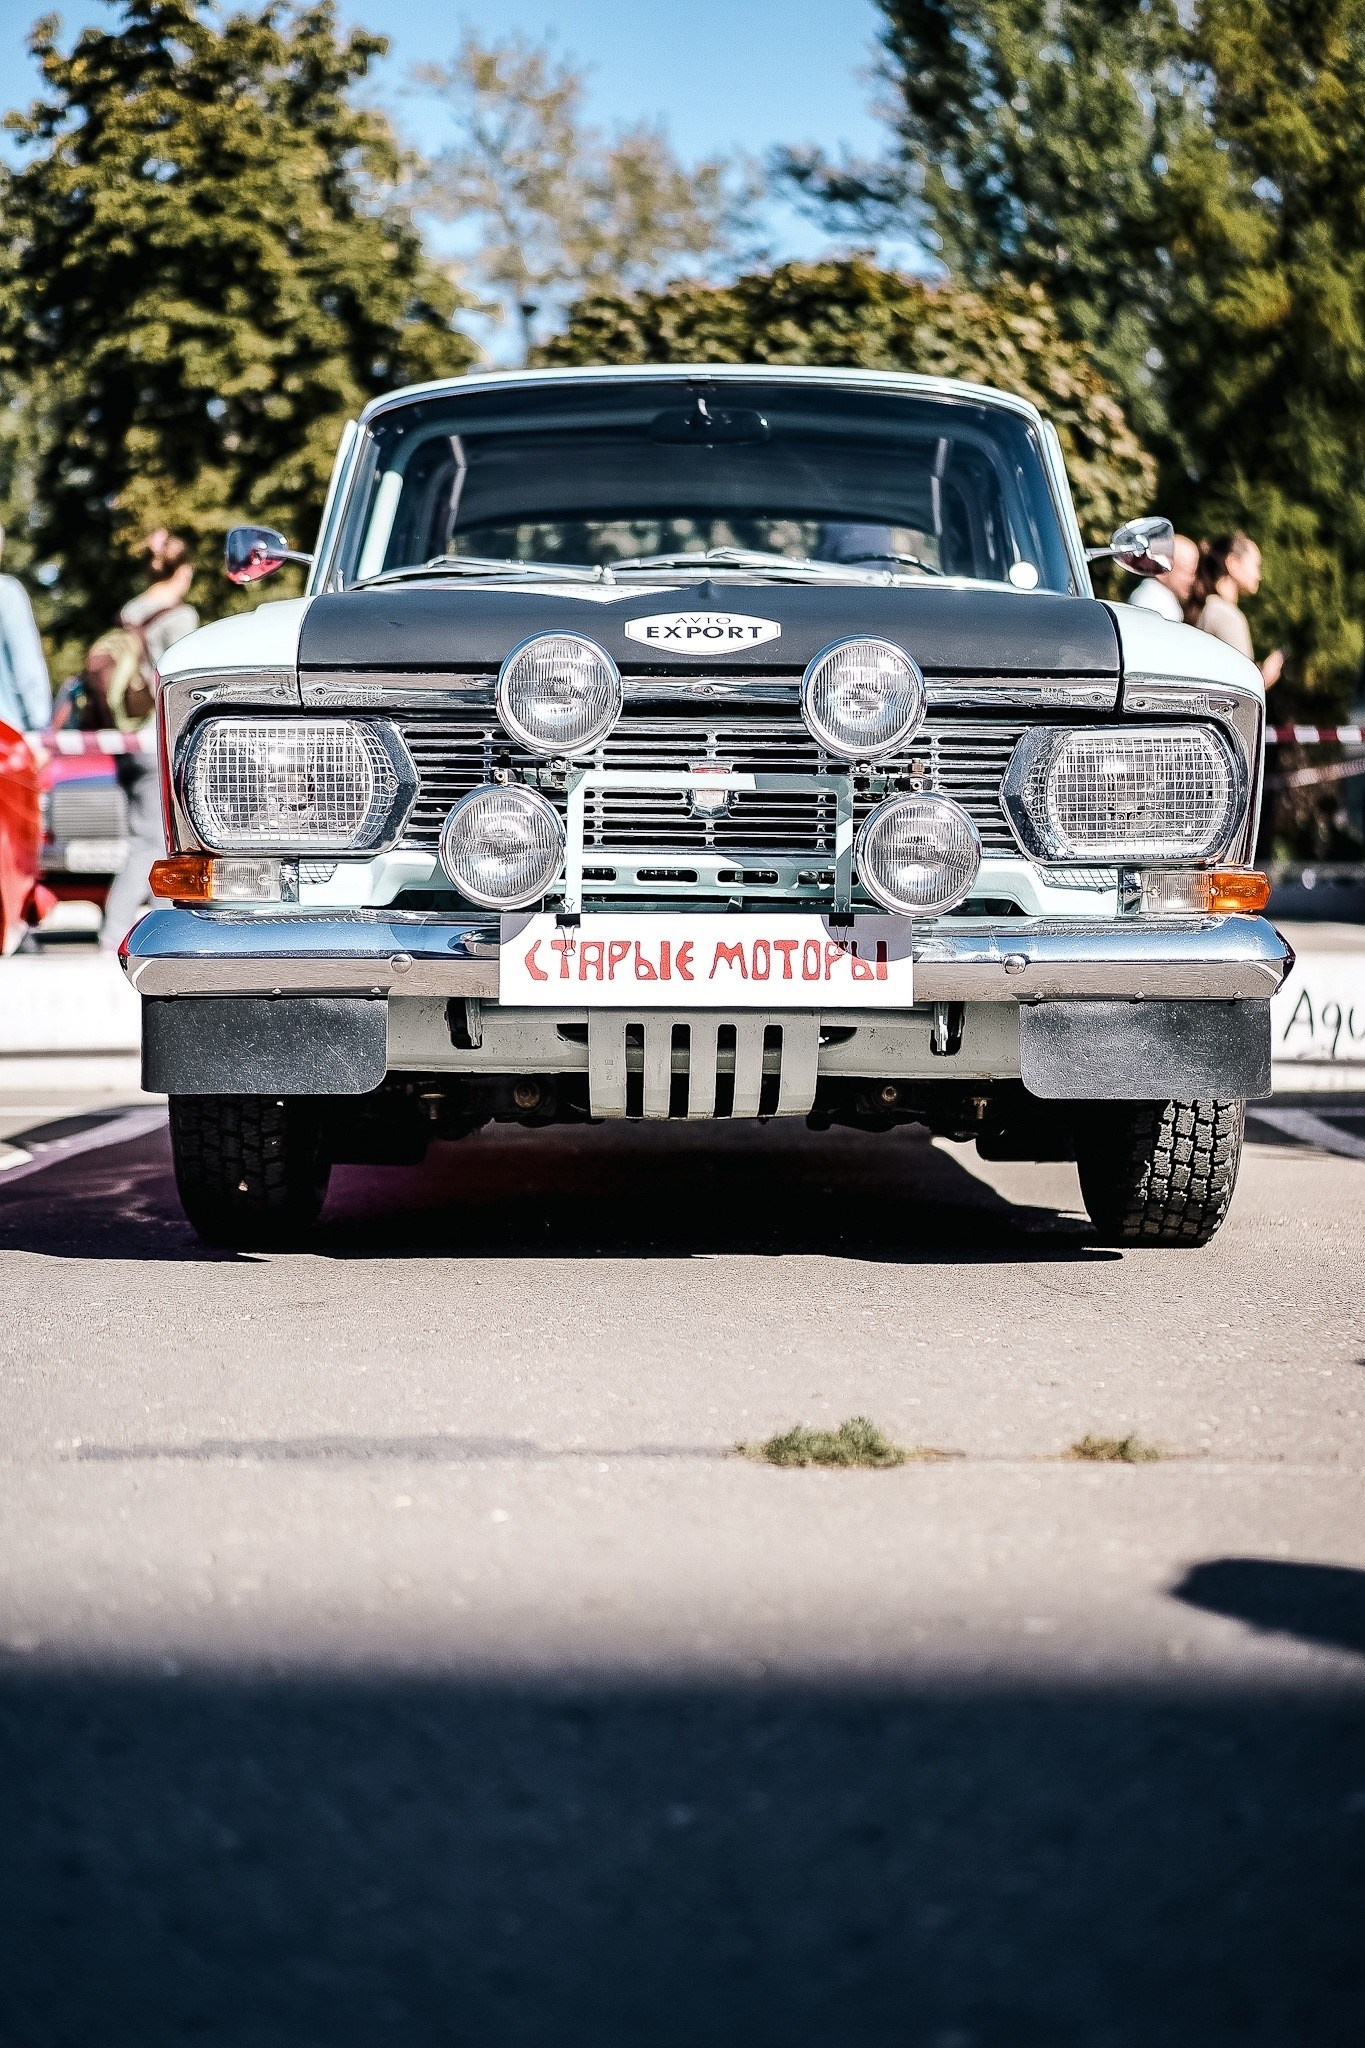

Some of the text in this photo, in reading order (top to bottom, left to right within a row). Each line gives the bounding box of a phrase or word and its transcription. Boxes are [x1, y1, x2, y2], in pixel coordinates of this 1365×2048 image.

[675, 617, 731, 625] AVTO
[646, 626, 763, 639] EXPORT
[524, 939, 889, 981] СТАРЫЕ МОТОРЫ
